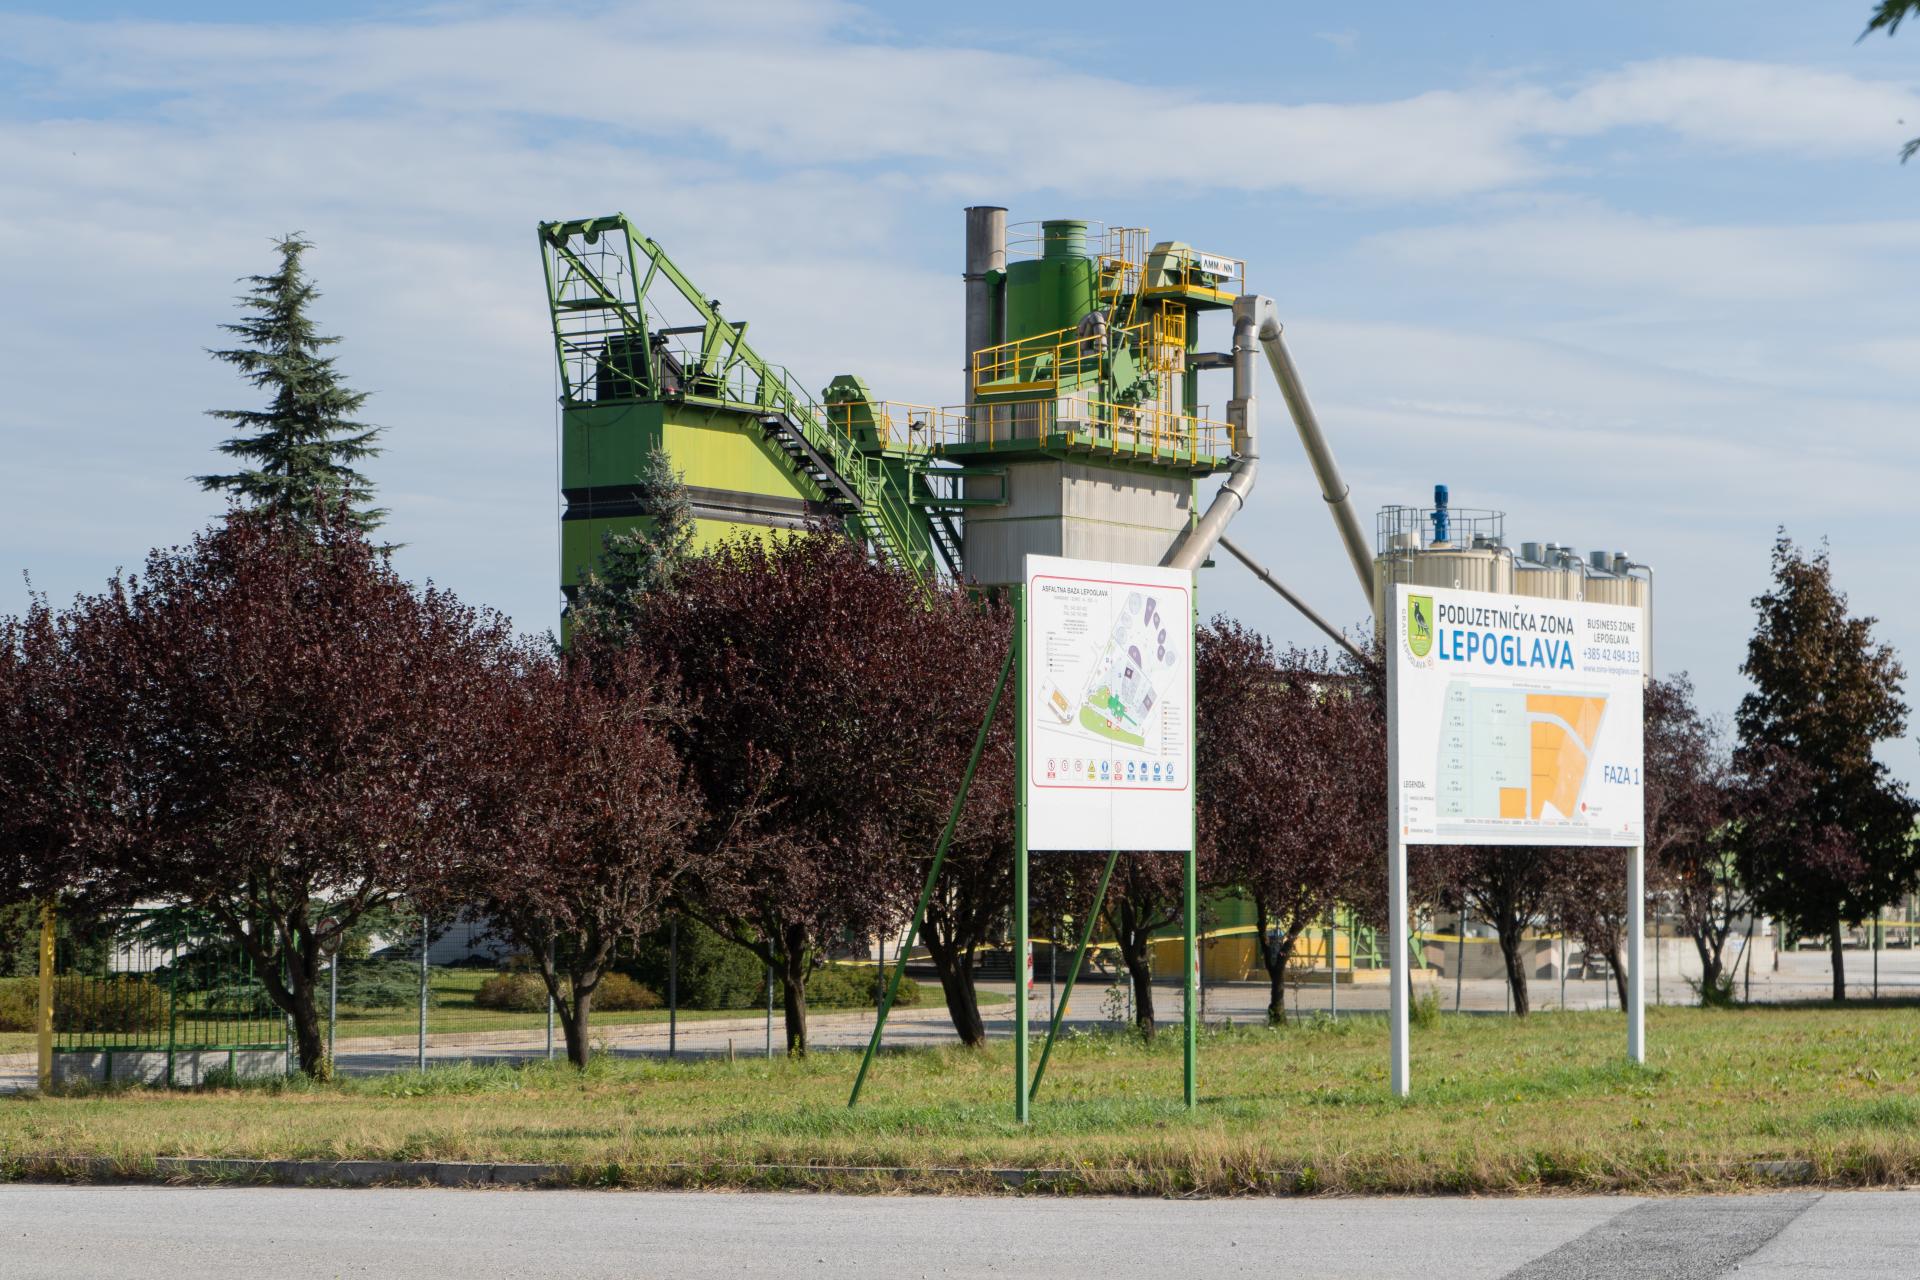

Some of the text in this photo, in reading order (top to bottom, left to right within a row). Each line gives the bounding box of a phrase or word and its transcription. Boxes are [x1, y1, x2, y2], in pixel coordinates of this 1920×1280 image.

[1203, 259, 1233, 273] AMMANN
[1042, 585, 1066, 594] ASFALTNA
[1081, 588, 1109, 597] LEPOGLAVA
[1439, 604, 1574, 635] PODUZETNIČKA ZONA
[1587, 618, 1636, 633] BUSINESS ZONE
[1593, 631, 1630, 645] LEPOGLAVA
[1439, 628, 1575, 671] LEPOGLAVA
[1583, 647, 1640, 663] +385 42 494 313
[1604, 765, 1640, 785] FAZA 1
